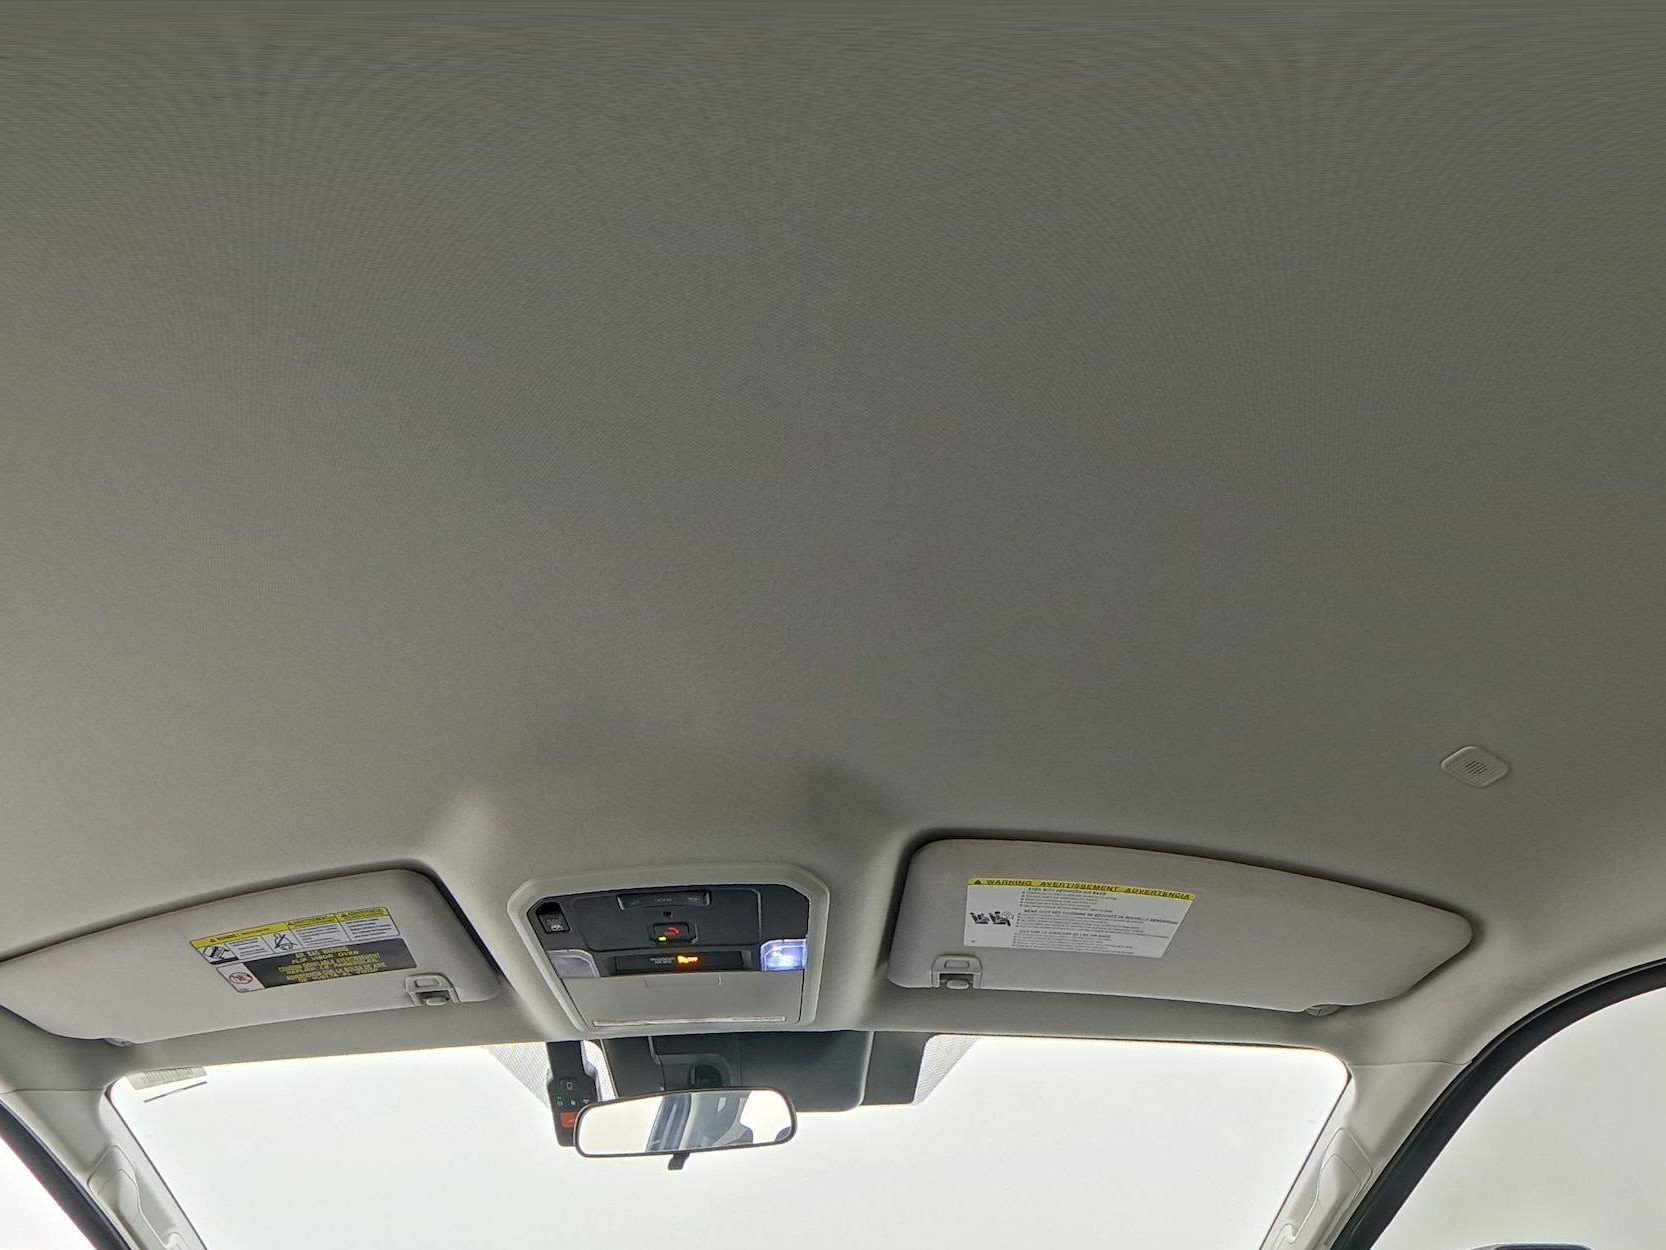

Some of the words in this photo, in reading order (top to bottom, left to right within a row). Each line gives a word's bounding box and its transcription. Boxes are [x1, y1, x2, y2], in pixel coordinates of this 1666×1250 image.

[986, 879, 1033, 887] WARNING
[1125, 887, 1191, 900] ADVERTENCIA
[338, 950, 359, 958] OVER
